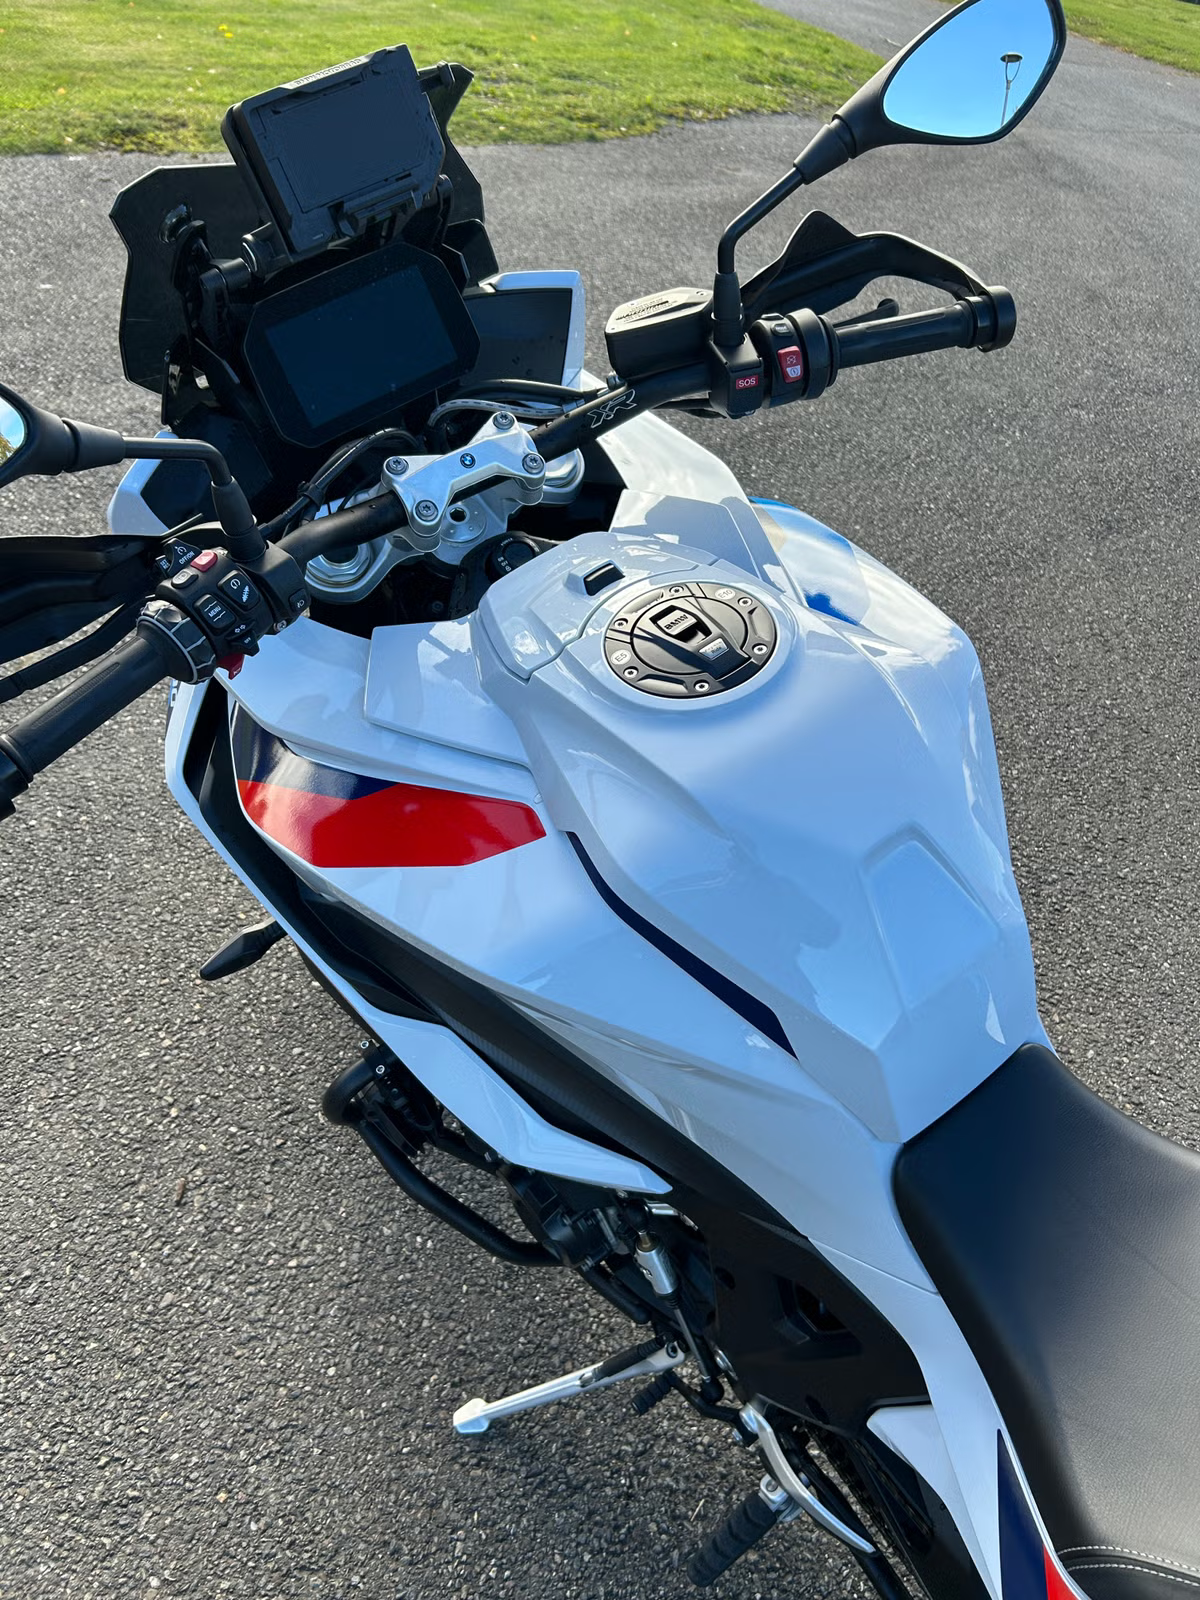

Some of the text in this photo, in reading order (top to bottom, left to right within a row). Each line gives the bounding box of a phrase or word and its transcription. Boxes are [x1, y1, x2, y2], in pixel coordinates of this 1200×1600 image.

[738, 377, 756, 388] SOS
[587, 388, 637, 428] XR
[718, 588, 733, 599] E10
[208, 605, 221, 617] MENU
[664, 613, 689, 631] BMW
[614, 652, 628, 663] E5
